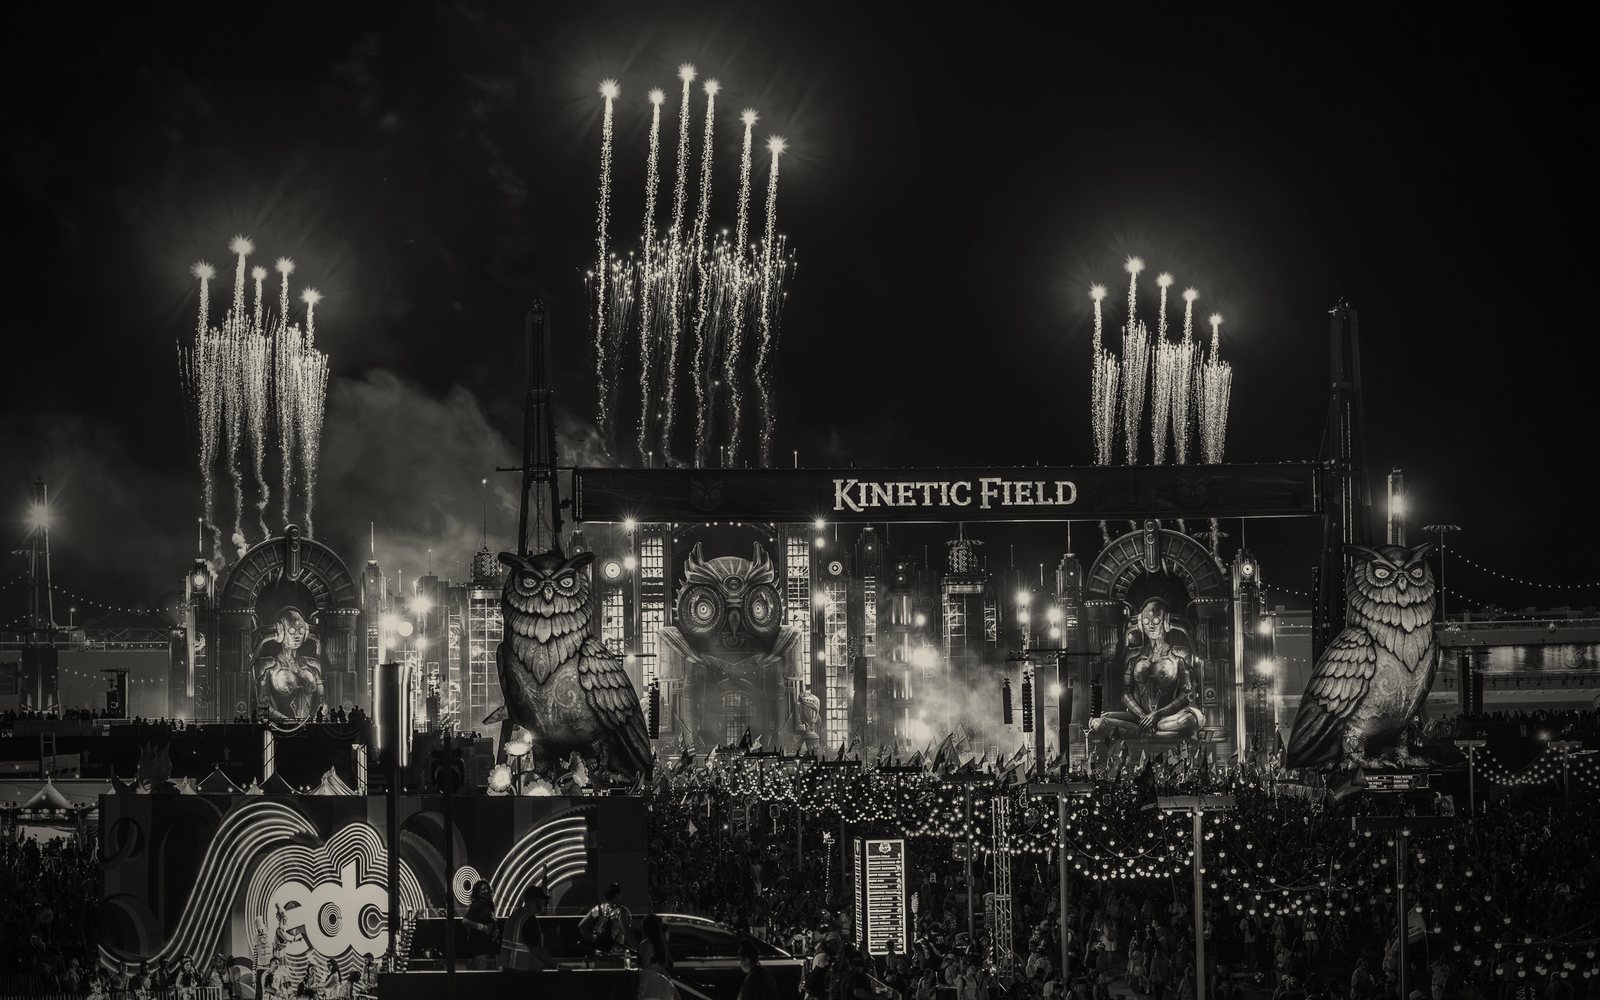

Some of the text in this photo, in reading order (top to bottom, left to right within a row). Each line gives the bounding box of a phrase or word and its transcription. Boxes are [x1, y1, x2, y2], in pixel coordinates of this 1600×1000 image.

[832, 477, 1078, 512] KINETIC FIELD
[267, 859, 389, 956] edc
